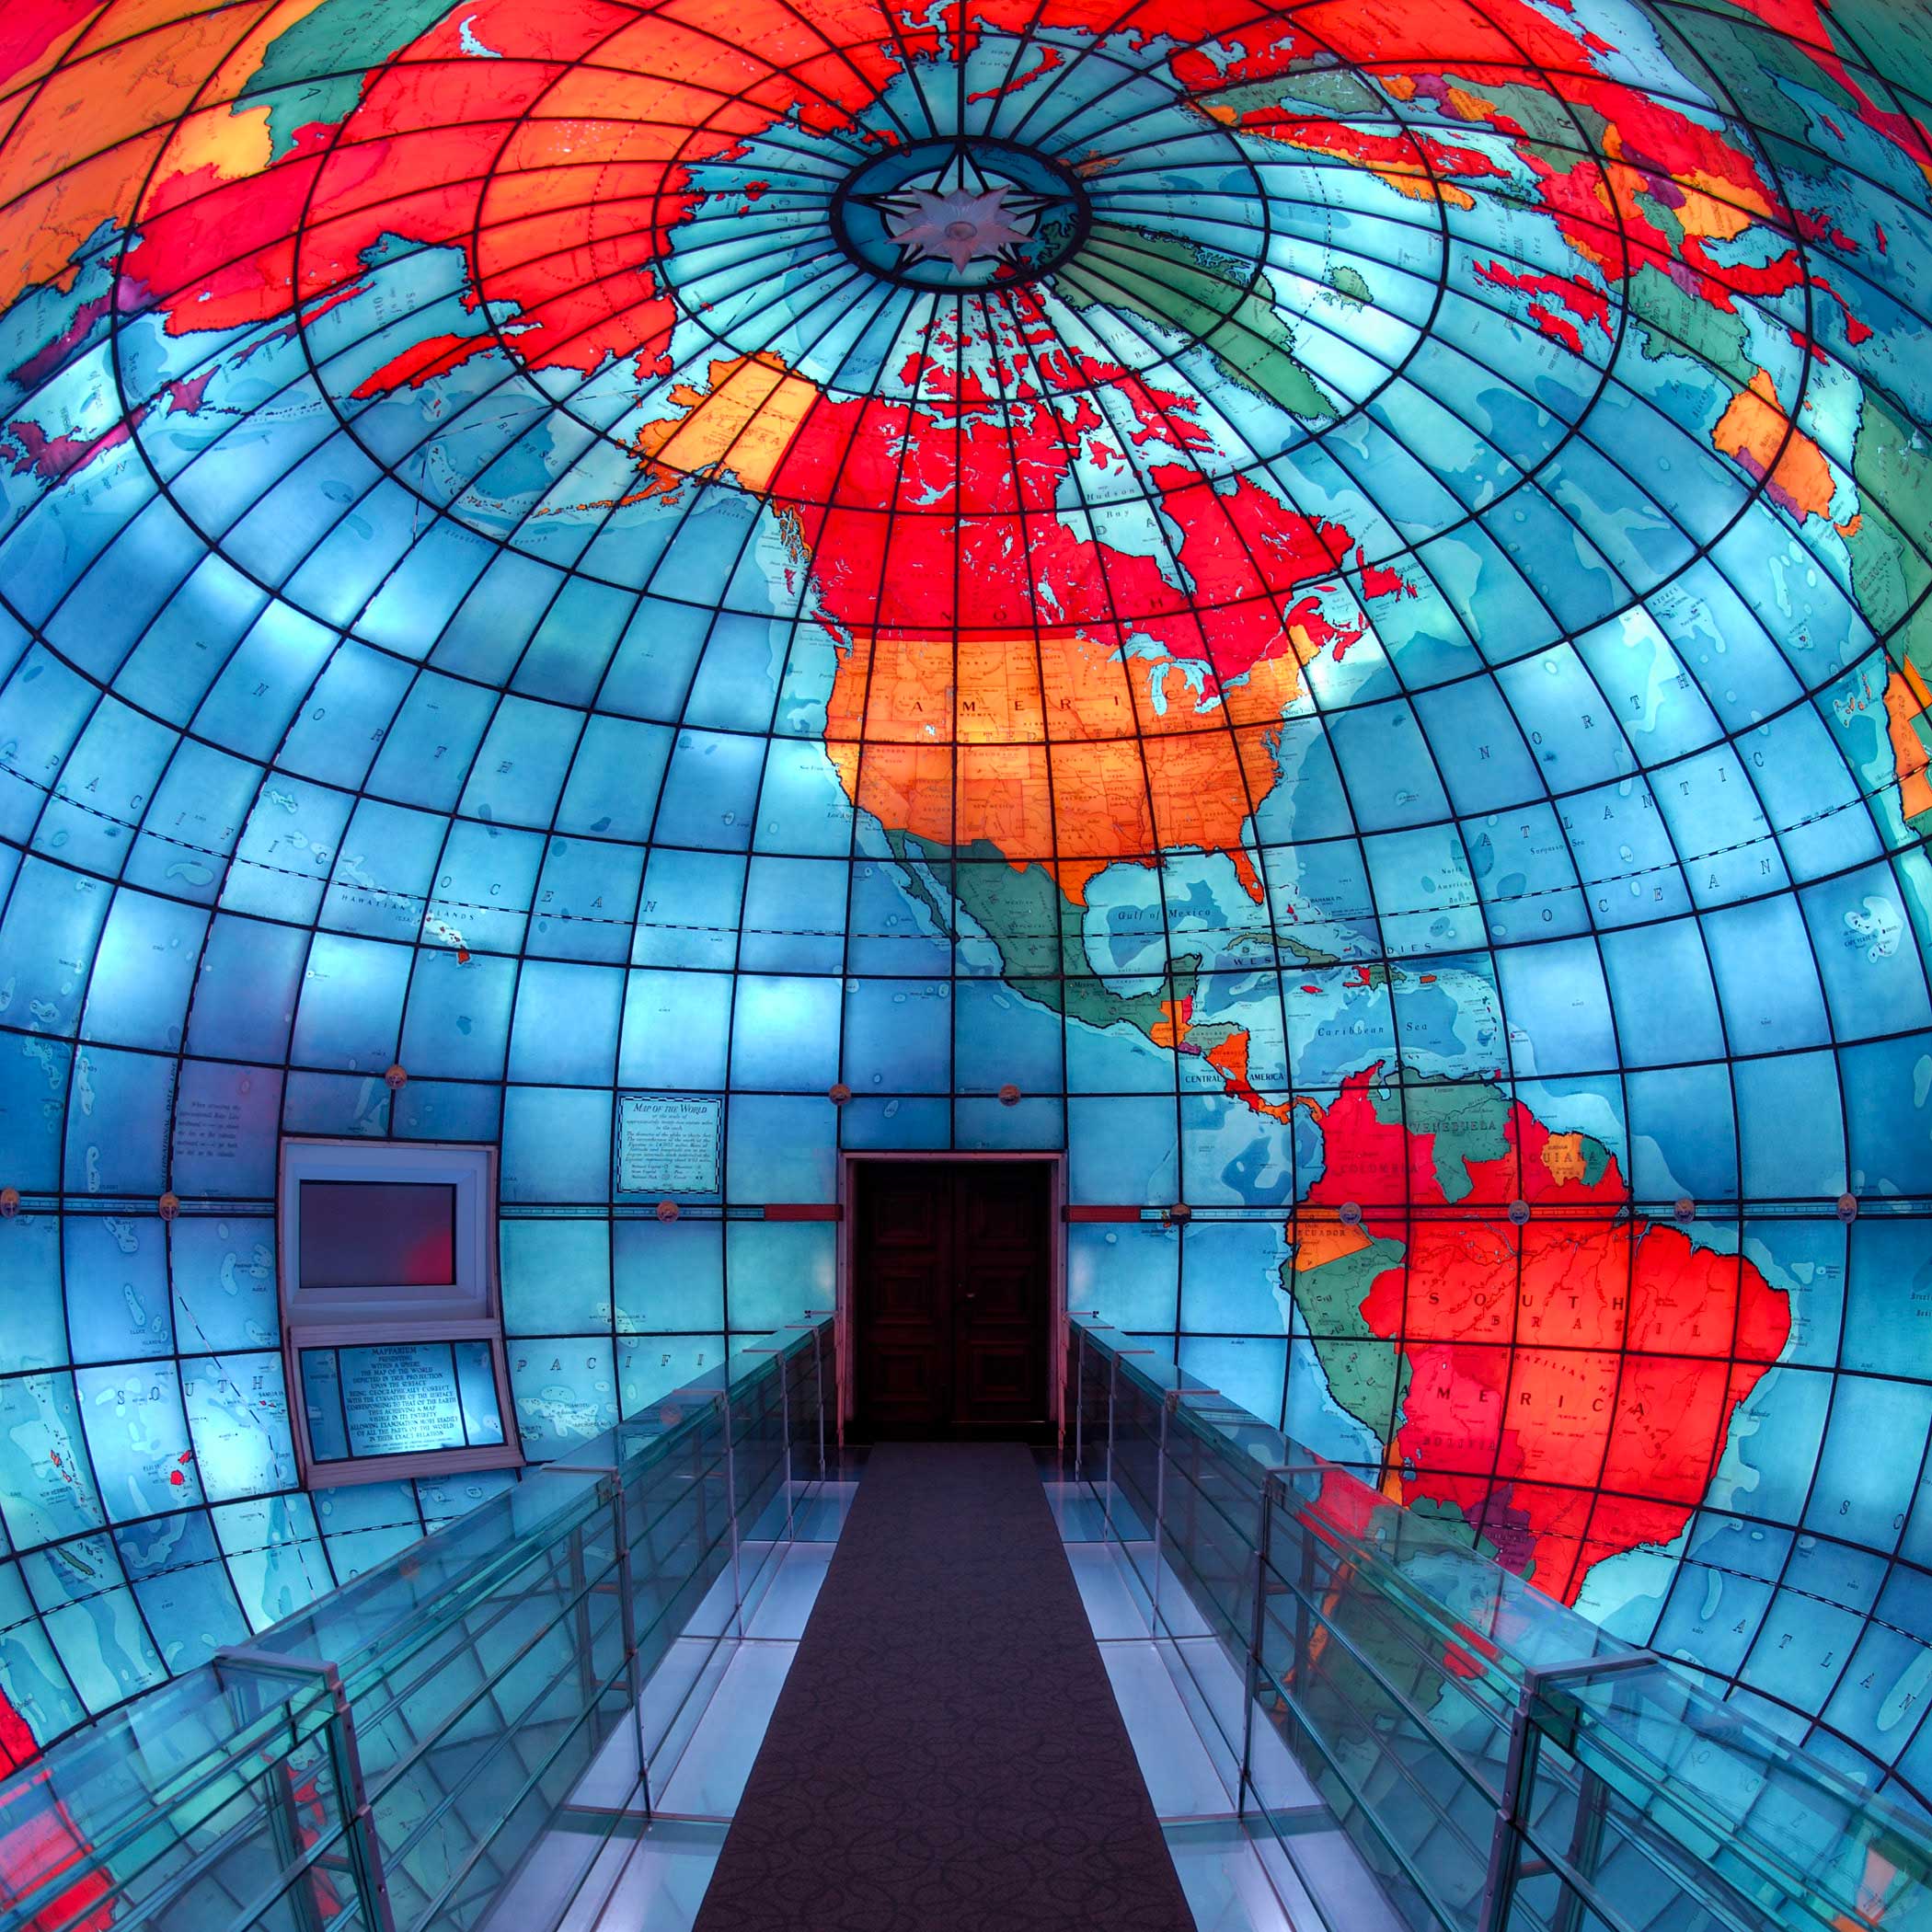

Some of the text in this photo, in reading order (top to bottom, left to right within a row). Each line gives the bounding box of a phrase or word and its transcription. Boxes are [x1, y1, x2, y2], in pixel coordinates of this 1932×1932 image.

[705, 412, 780, 445] ALASKA
[1087, 489, 1135, 501] Hudson
[1106, 510, 1129, 518] Bay
[1479, 673, 1690, 760] NORTH
[253, 682, 513, 775] NORTH
[1480, 752, 1765, 848] ATLANTIC
[45, 754, 328, 866] PACIFIC
[1571, 839, 1585, 847] Sea
[440, 876, 658, 914] OCEAN
[1542, 858, 1771, 922] OCEAN
[342, 894, 405, 911] HAWAIIAN
[1119, 909, 1211, 920] Gulf of Mexico
[1359, 942, 1432, 957] INDIES
[1317, 1021, 1428, 1037] Caribbean Sea
[1249, 1073, 1284, 1081] AMERICA
[1413, 1121, 1496, 1133] VENEZUELA
[1528, 1152, 1598, 1163] GUIANA
[1340, 1165, 1419, 1174] COLOMBIA
[1296, 1229, 1346, 1237] ECUADOR
[1428, 1292, 1625, 1311] SOUTH
[1490, 1315, 1701, 1338] BRAZIL
[517, 1353, 705, 1373] PACIFI
[117, 1374, 264, 1406] SOUTH
[1399, 1385, 1645, 1415] AMERICA
